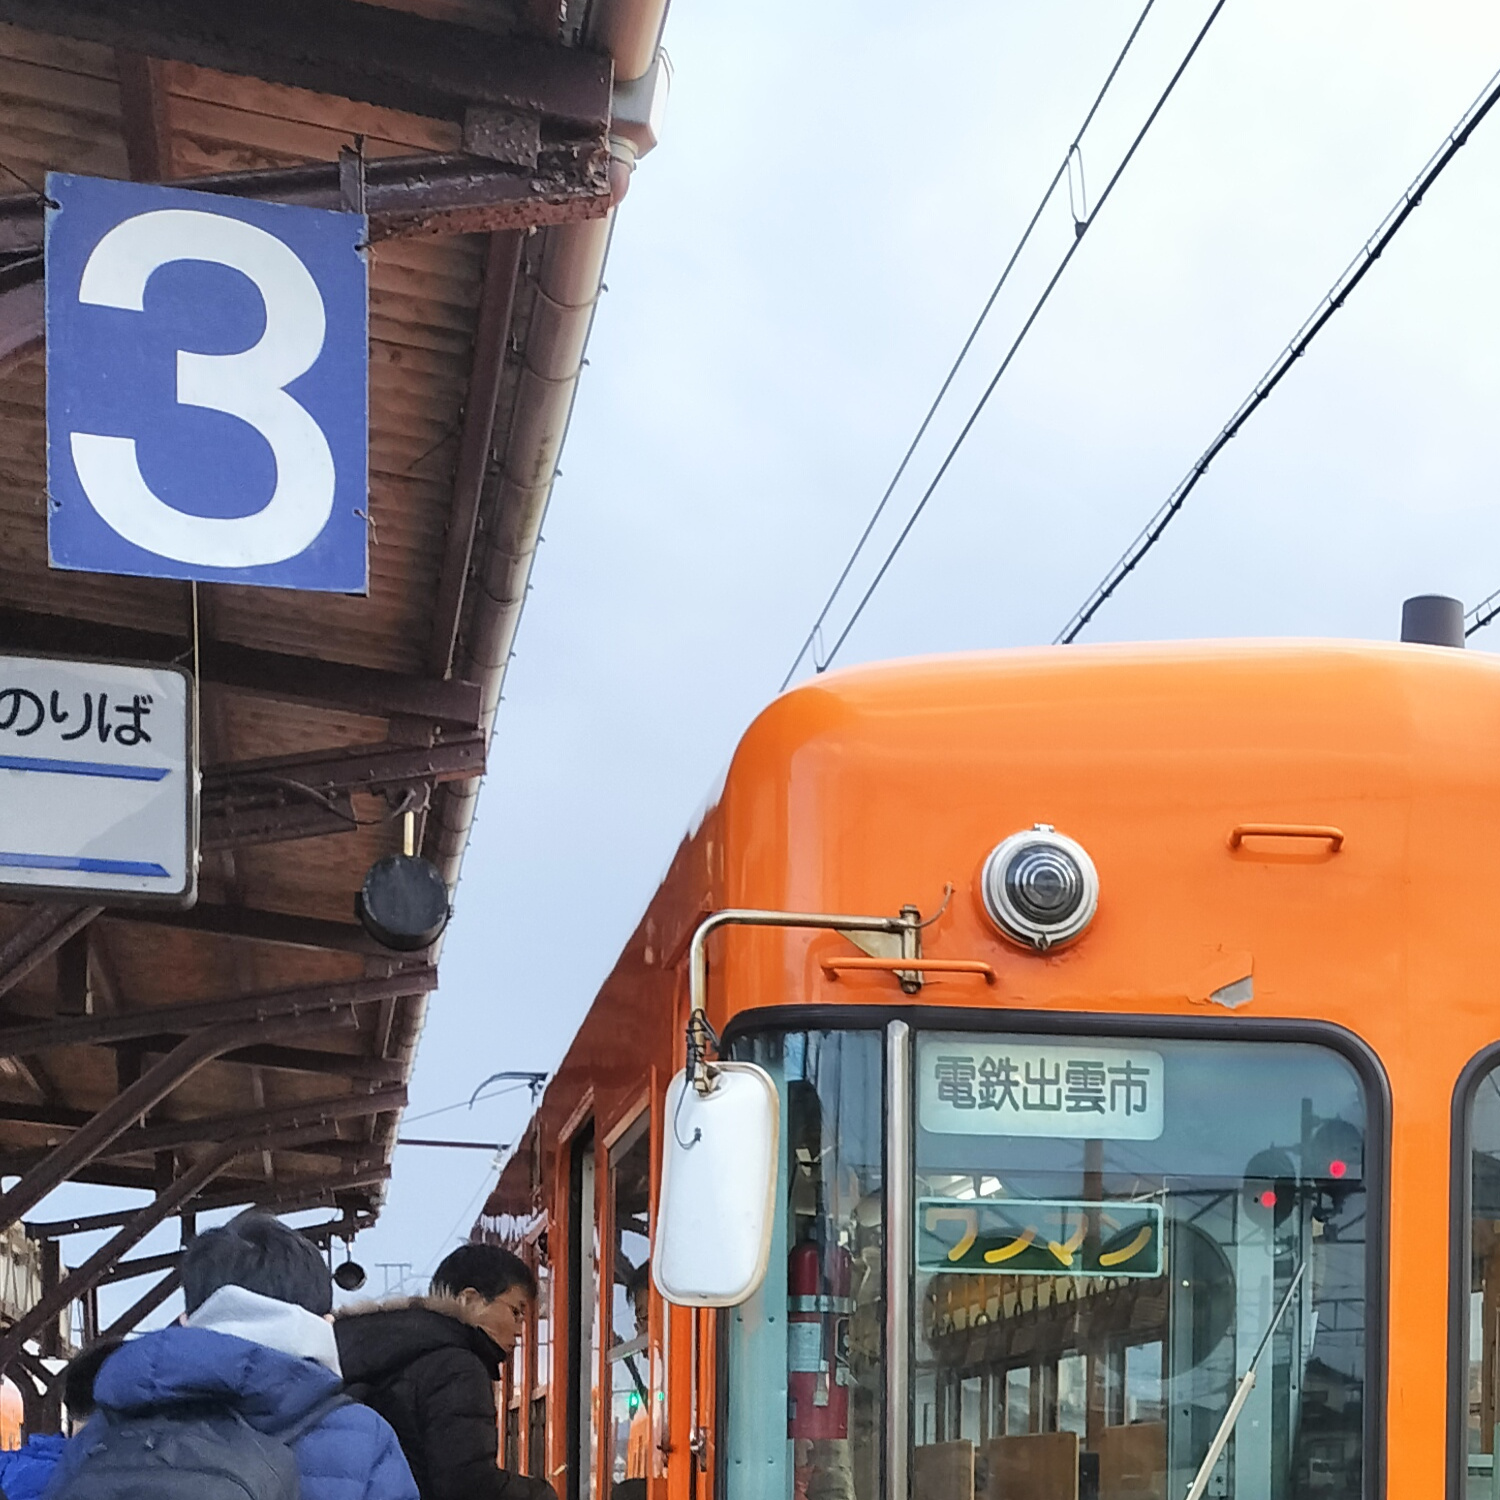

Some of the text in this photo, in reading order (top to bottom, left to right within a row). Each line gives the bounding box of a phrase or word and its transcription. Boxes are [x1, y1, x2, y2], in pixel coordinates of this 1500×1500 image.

[70, 209, 337, 568] 3
[0, 688, 153, 745] のりば
[935, 1056, 1151, 1116] 電鉄出雲市
[925, 1206, 1152, 1267] ワンマン
